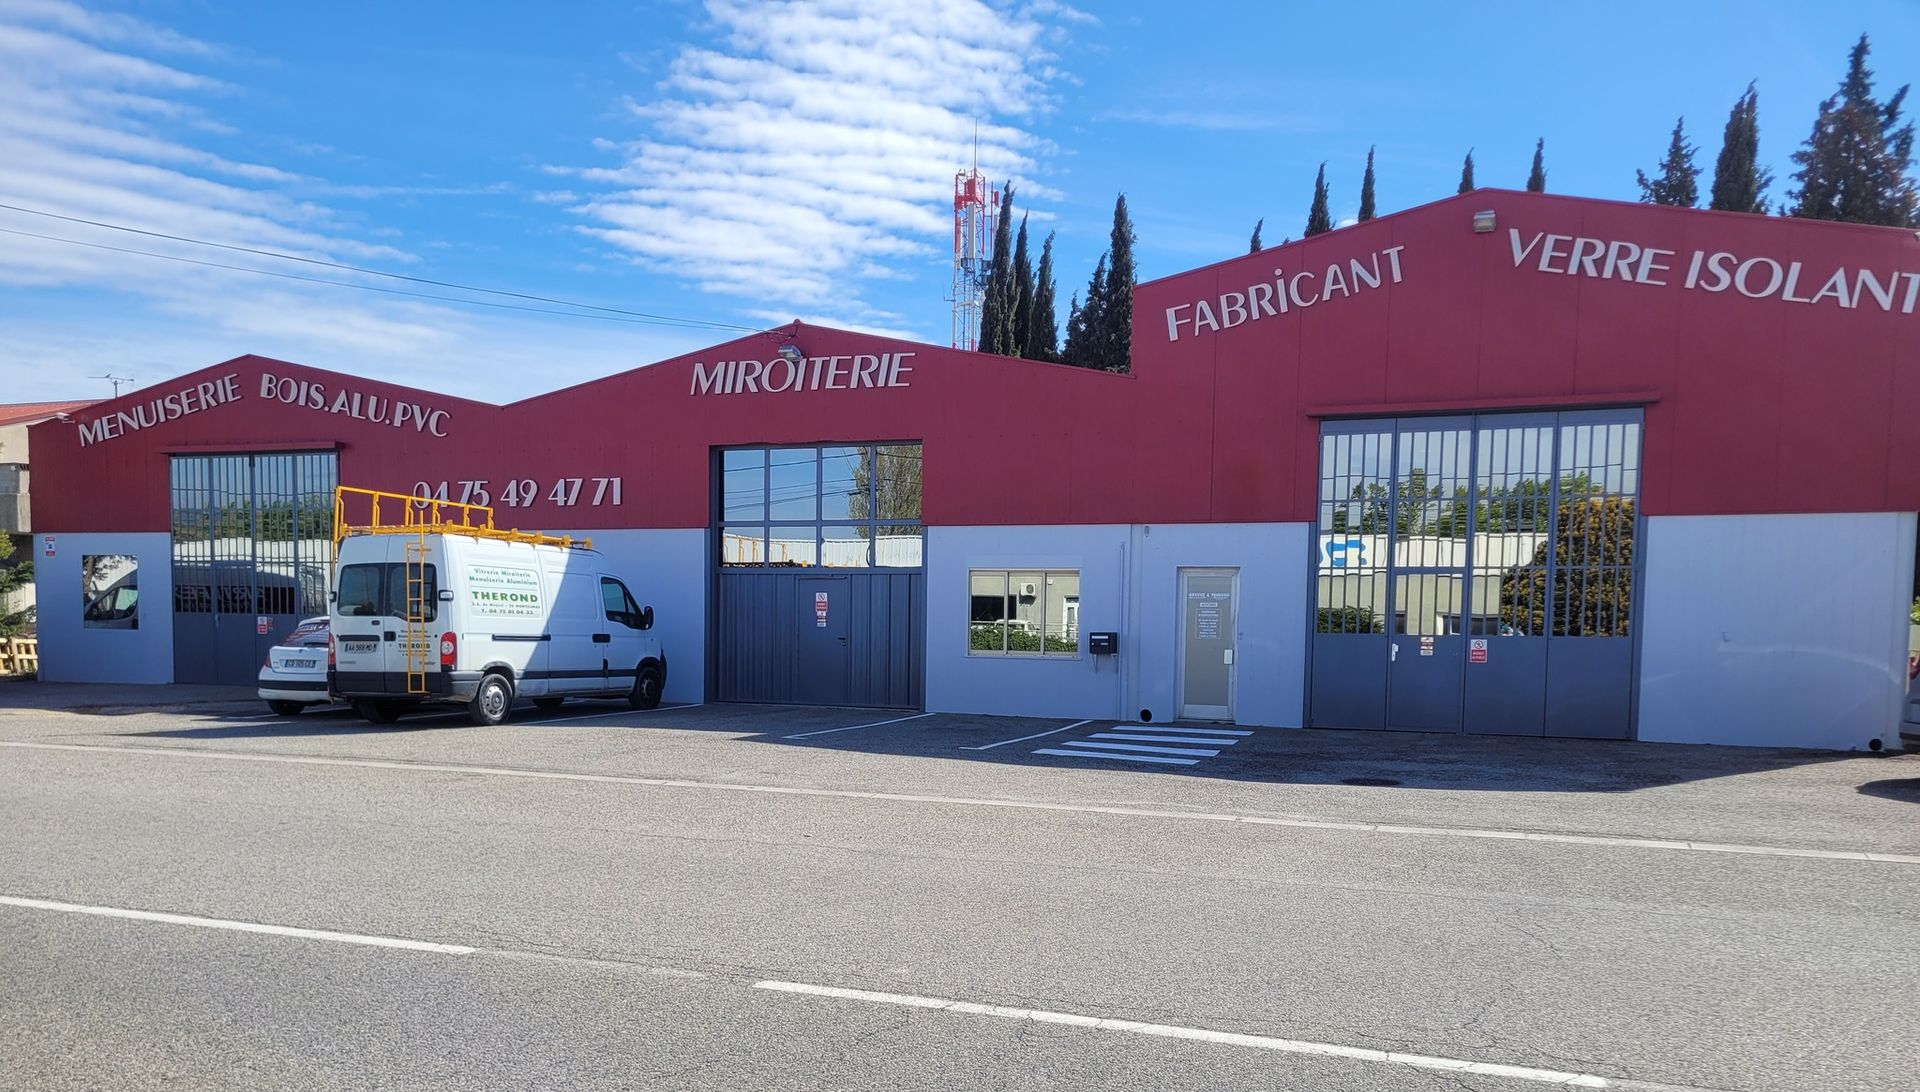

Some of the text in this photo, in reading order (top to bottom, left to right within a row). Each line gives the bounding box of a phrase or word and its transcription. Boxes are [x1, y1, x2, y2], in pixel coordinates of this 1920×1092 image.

[1509, 228, 1920, 314] VERRE ISOLANT
[690, 352, 916, 396] MIROITERIE
[78, 373, 243, 447] MENUISERIE
[413, 477, 622, 509] 04 75 49 47 71
[472, 591, 538, 603] THEROND
